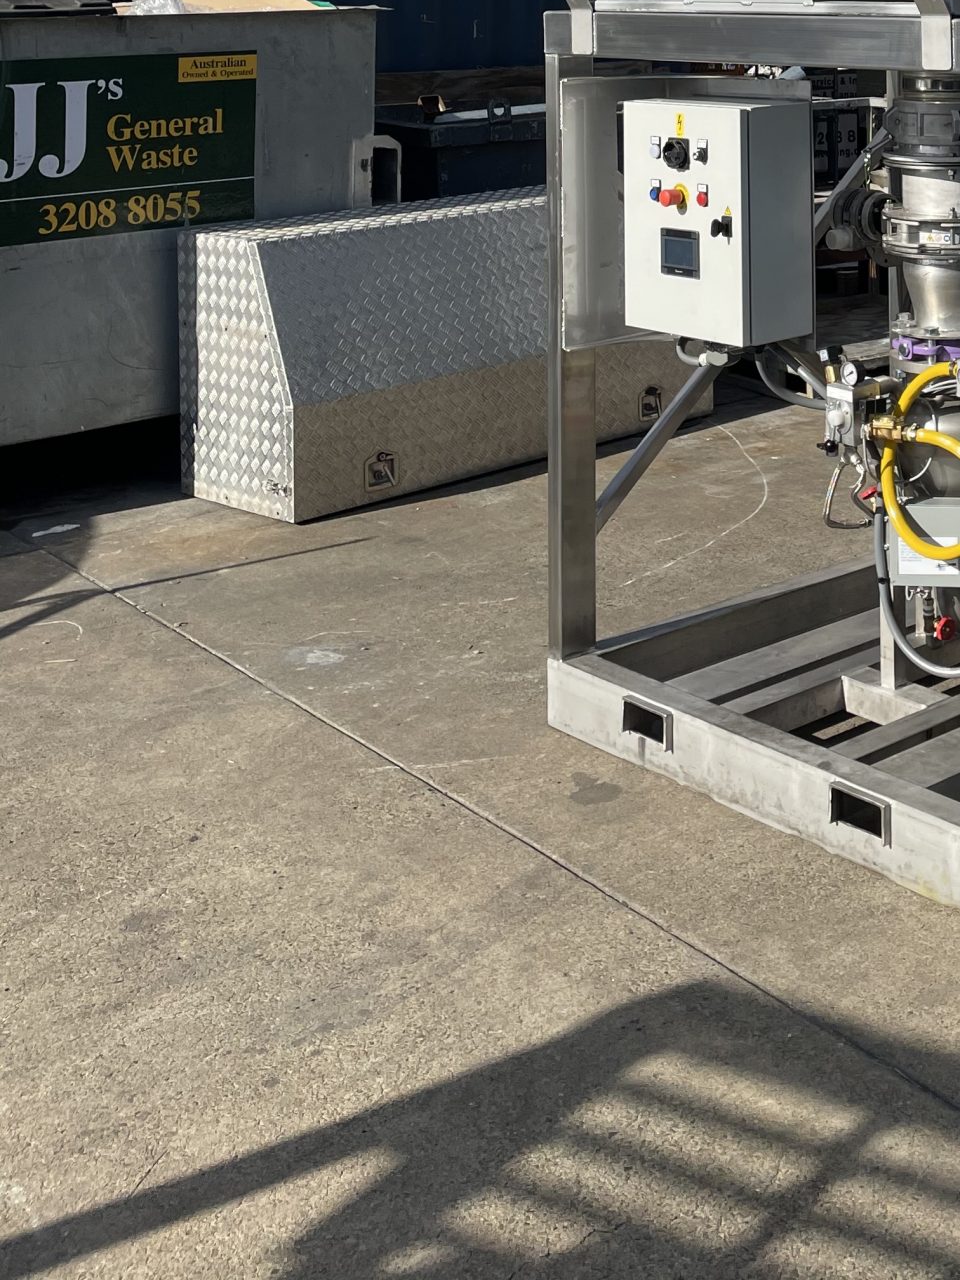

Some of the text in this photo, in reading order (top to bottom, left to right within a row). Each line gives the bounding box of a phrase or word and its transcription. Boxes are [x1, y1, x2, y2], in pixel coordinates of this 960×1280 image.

[191, 58, 247, 69] Australian
[220, 68, 254, 78] Operated
[106, 109, 223, 142] General
[106, 144, 199, 173] Waste
[38, 190, 200, 235] 3208 8055
